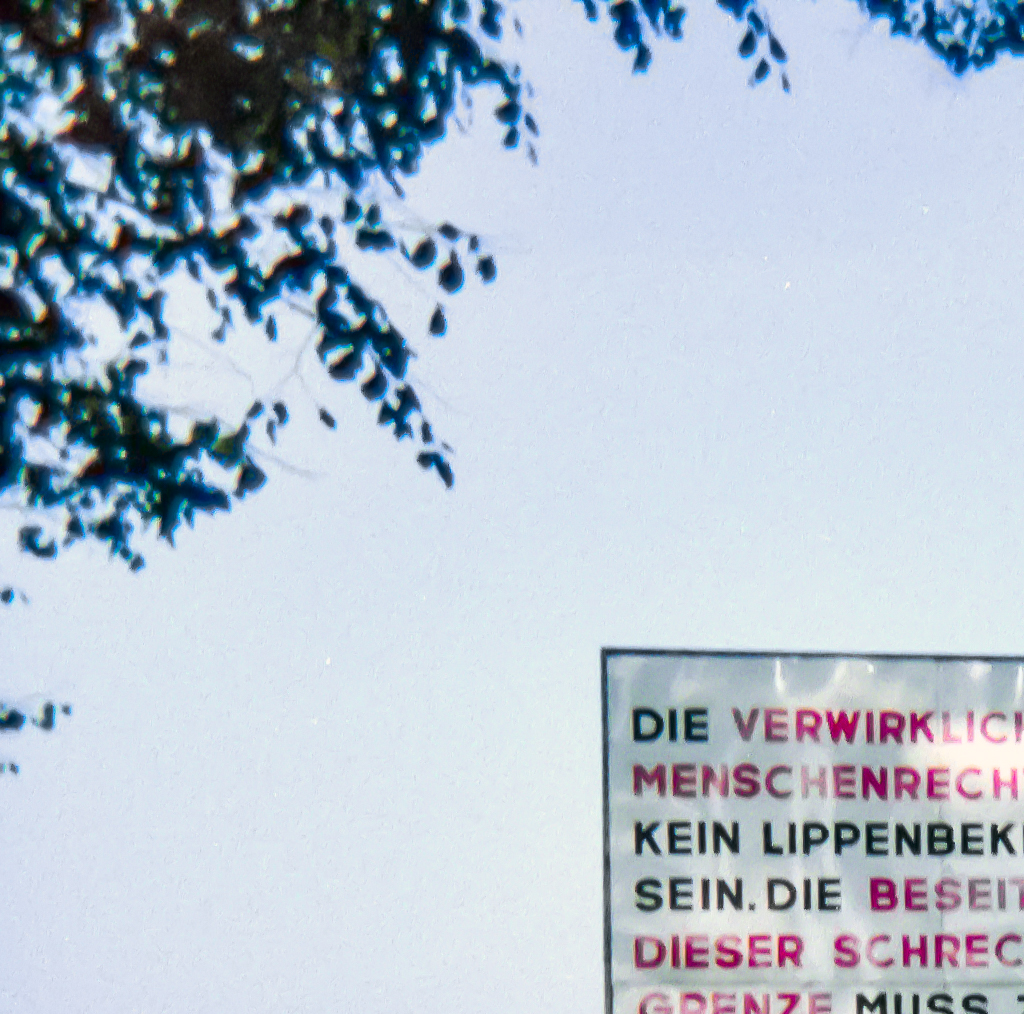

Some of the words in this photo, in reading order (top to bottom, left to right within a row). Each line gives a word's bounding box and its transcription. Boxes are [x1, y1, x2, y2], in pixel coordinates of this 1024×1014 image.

[632, 707, 709, 742] DIE
[634, 820, 740, 855] KEIN
[633, 877, 755, 912] SEIN.
[767, 877, 842, 912] DIE
[633, 936, 803, 968] DIESER
